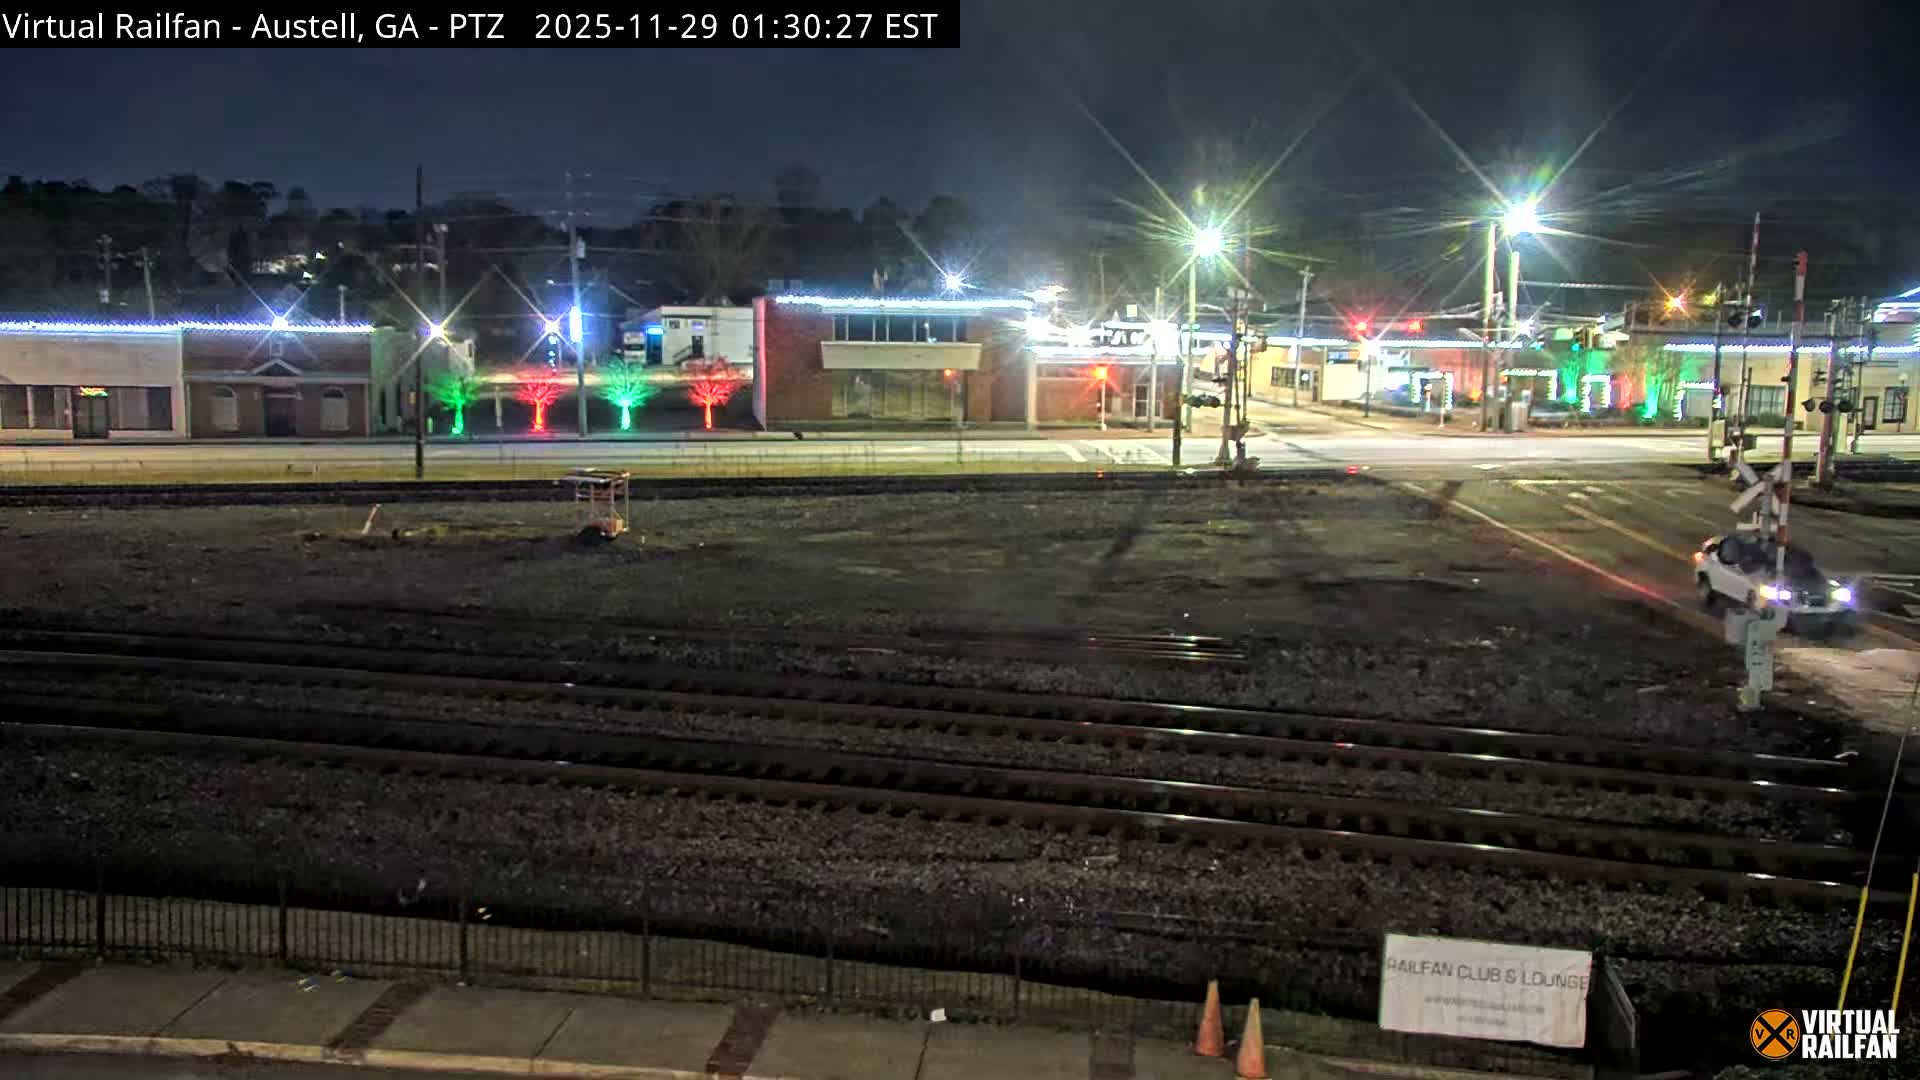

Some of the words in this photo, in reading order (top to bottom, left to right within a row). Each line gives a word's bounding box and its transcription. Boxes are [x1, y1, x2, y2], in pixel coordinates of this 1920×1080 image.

[1387, 958, 1453, 977] RAILFAN
[1457, 964, 1501, 983] CLUB
[1521, 971, 1590, 991] LOUNGE
